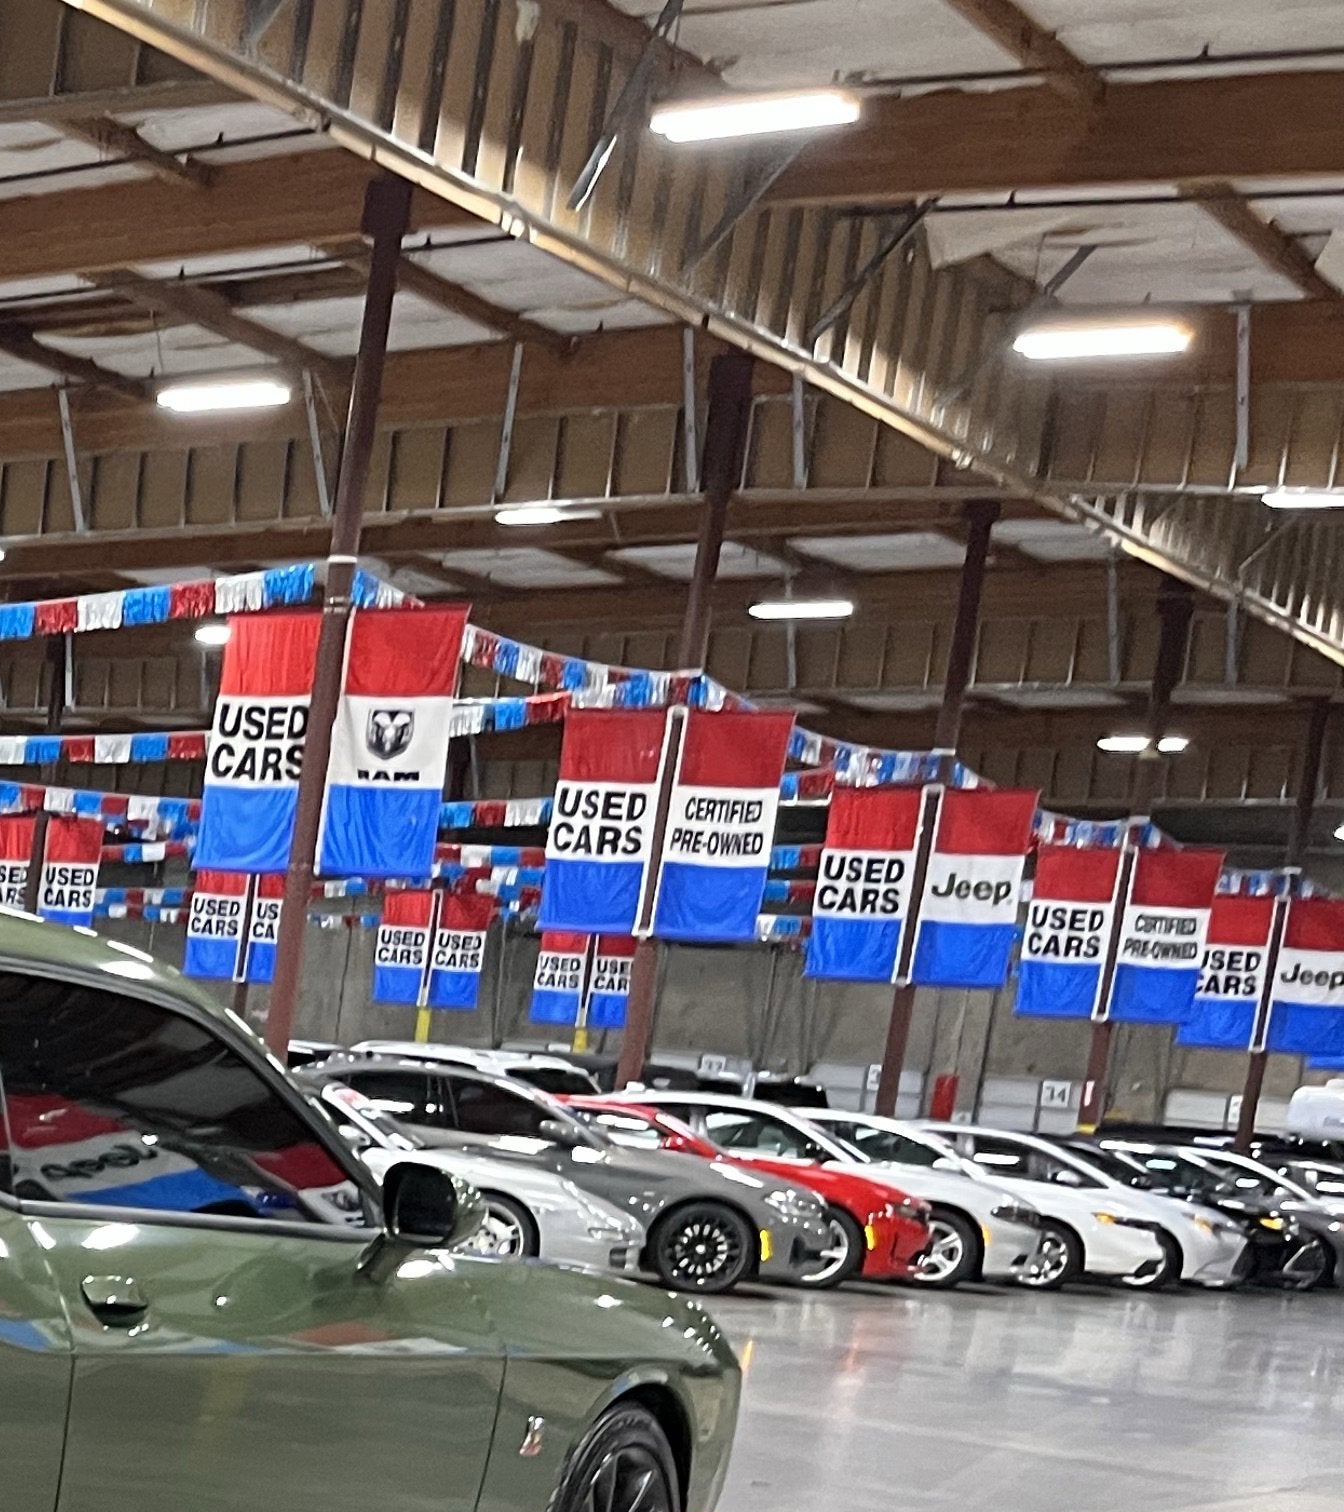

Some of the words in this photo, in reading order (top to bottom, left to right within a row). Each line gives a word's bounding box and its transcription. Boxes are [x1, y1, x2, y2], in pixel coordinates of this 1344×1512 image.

[218, 703, 310, 741] USED
[212, 743, 304, 782] CARS
[557, 787, 648, 822] USED
[684, 796, 763, 824] CERTIFIED
[553, 821, 643, 856] CARS
[670, 827, 764, 857] PRE-OWNED
[45, 867, 95, 887] USED
[823, 855, 905, 884] USED
[43, 887, 92, 908] CARS
[817, 885, 900, 914] CARS
[930, 872, 1012, 907] Jeep
[192, 897, 240, 917] USED
[256, 901, 280, 920] US
[190, 916, 239, 936] CARS
[1032, 904, 1104, 932] USED
[1135, 913, 1198, 936] CERTIFIED
[252, 921, 276, 940] CA
[379, 928, 425, 947] USED
[437, 931, 482, 950] USED
[377, 946, 423, 965] CARS
[1028, 932, 1101, 959] CARS
[434, 949, 480, 969] CARS
[539, 954, 581, 973] USED
[596, 957, 630, 976] USE
[536, 971, 579, 989] CARS
[593, 976, 628, 992] CAR
[1280, 962, 1344, 991] Jeep
